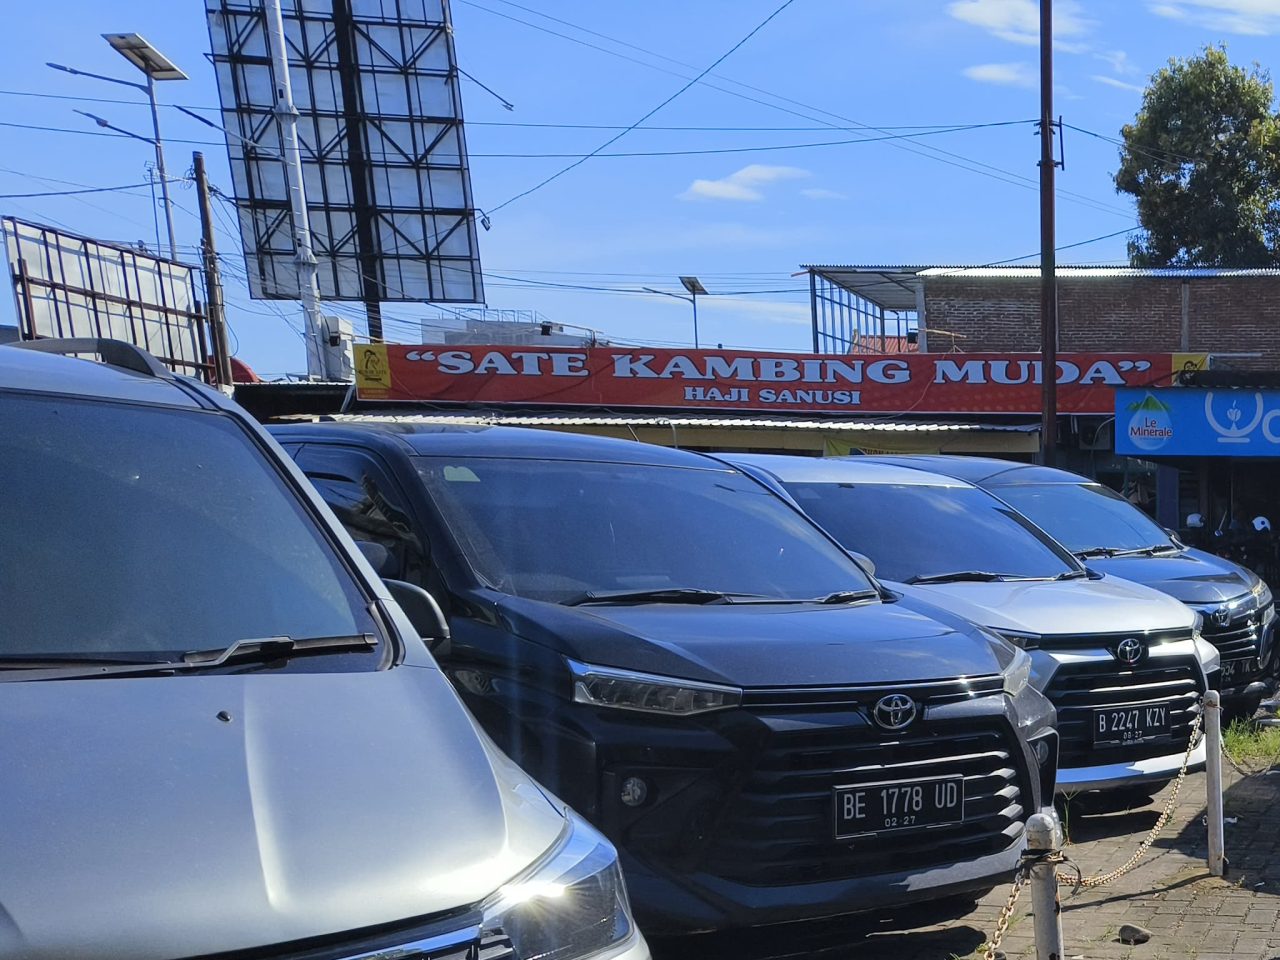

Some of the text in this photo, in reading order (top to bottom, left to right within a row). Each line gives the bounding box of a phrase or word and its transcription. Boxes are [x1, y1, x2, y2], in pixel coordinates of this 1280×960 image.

[611, 354, 911, 384] KAMBING
[683, 385, 862, 405] HAJI SANUSI
[1130, 426, 1173, 437] Minerale
[1145, 416, 1157, 428] Le
[1099, 707, 1166, 733] B 2247 KZY
[843, 782, 957, 820] BE 1778 UD
